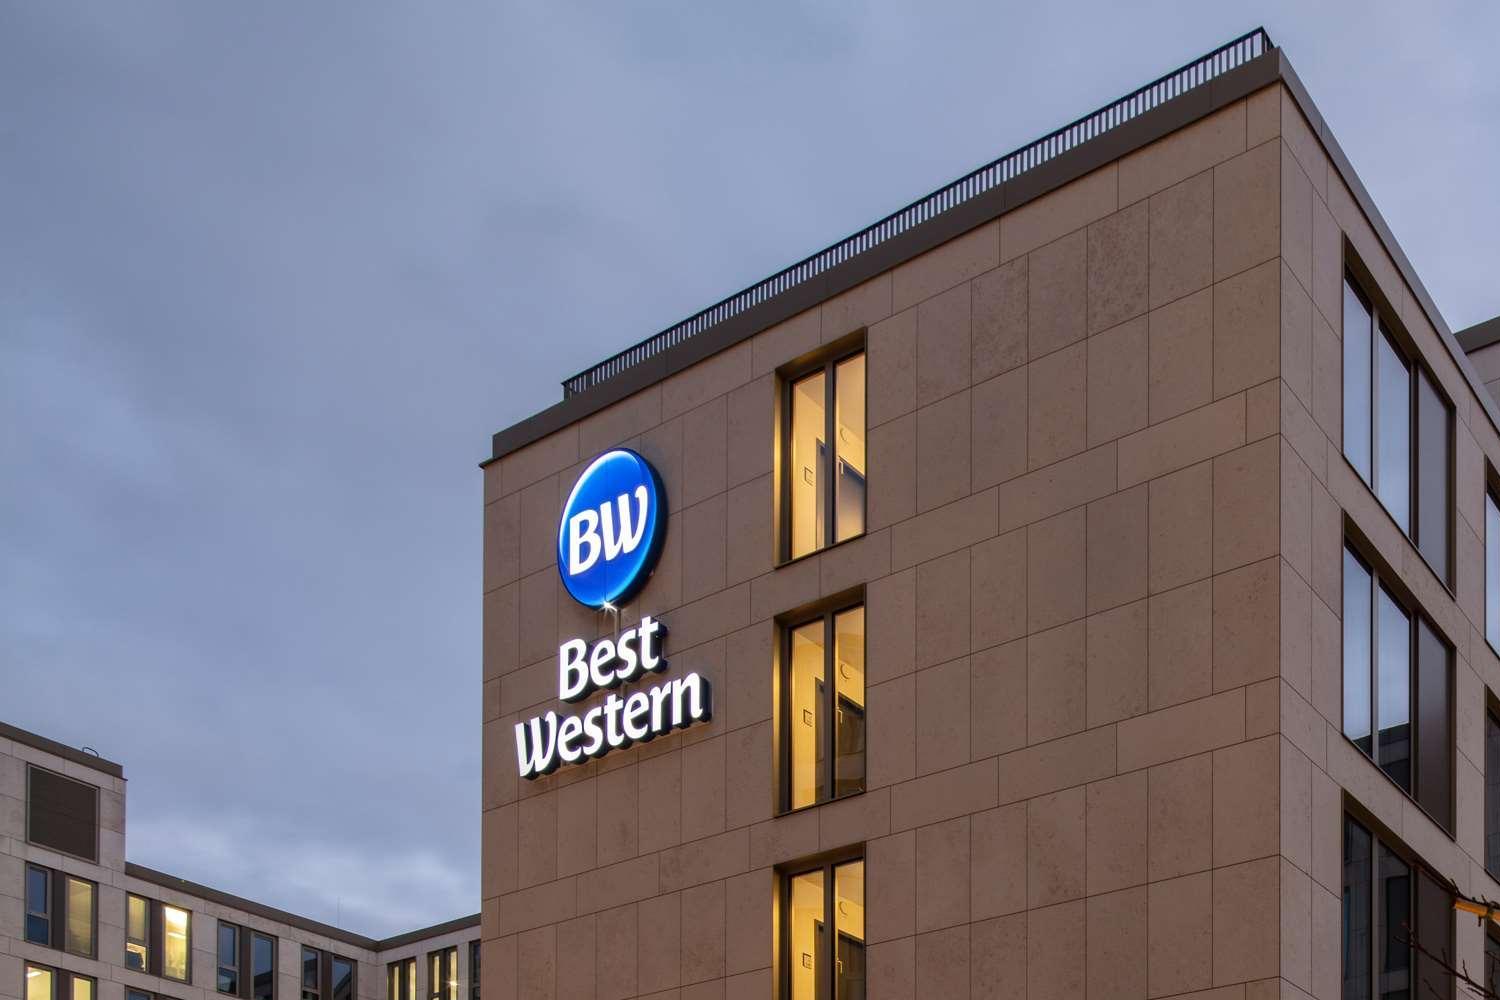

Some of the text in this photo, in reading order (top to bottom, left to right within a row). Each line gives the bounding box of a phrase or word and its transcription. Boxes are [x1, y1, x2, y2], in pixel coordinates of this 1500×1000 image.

[569, 485, 648, 576] BW
[559, 615, 661, 701] Best
[514, 672, 704, 777] Western
